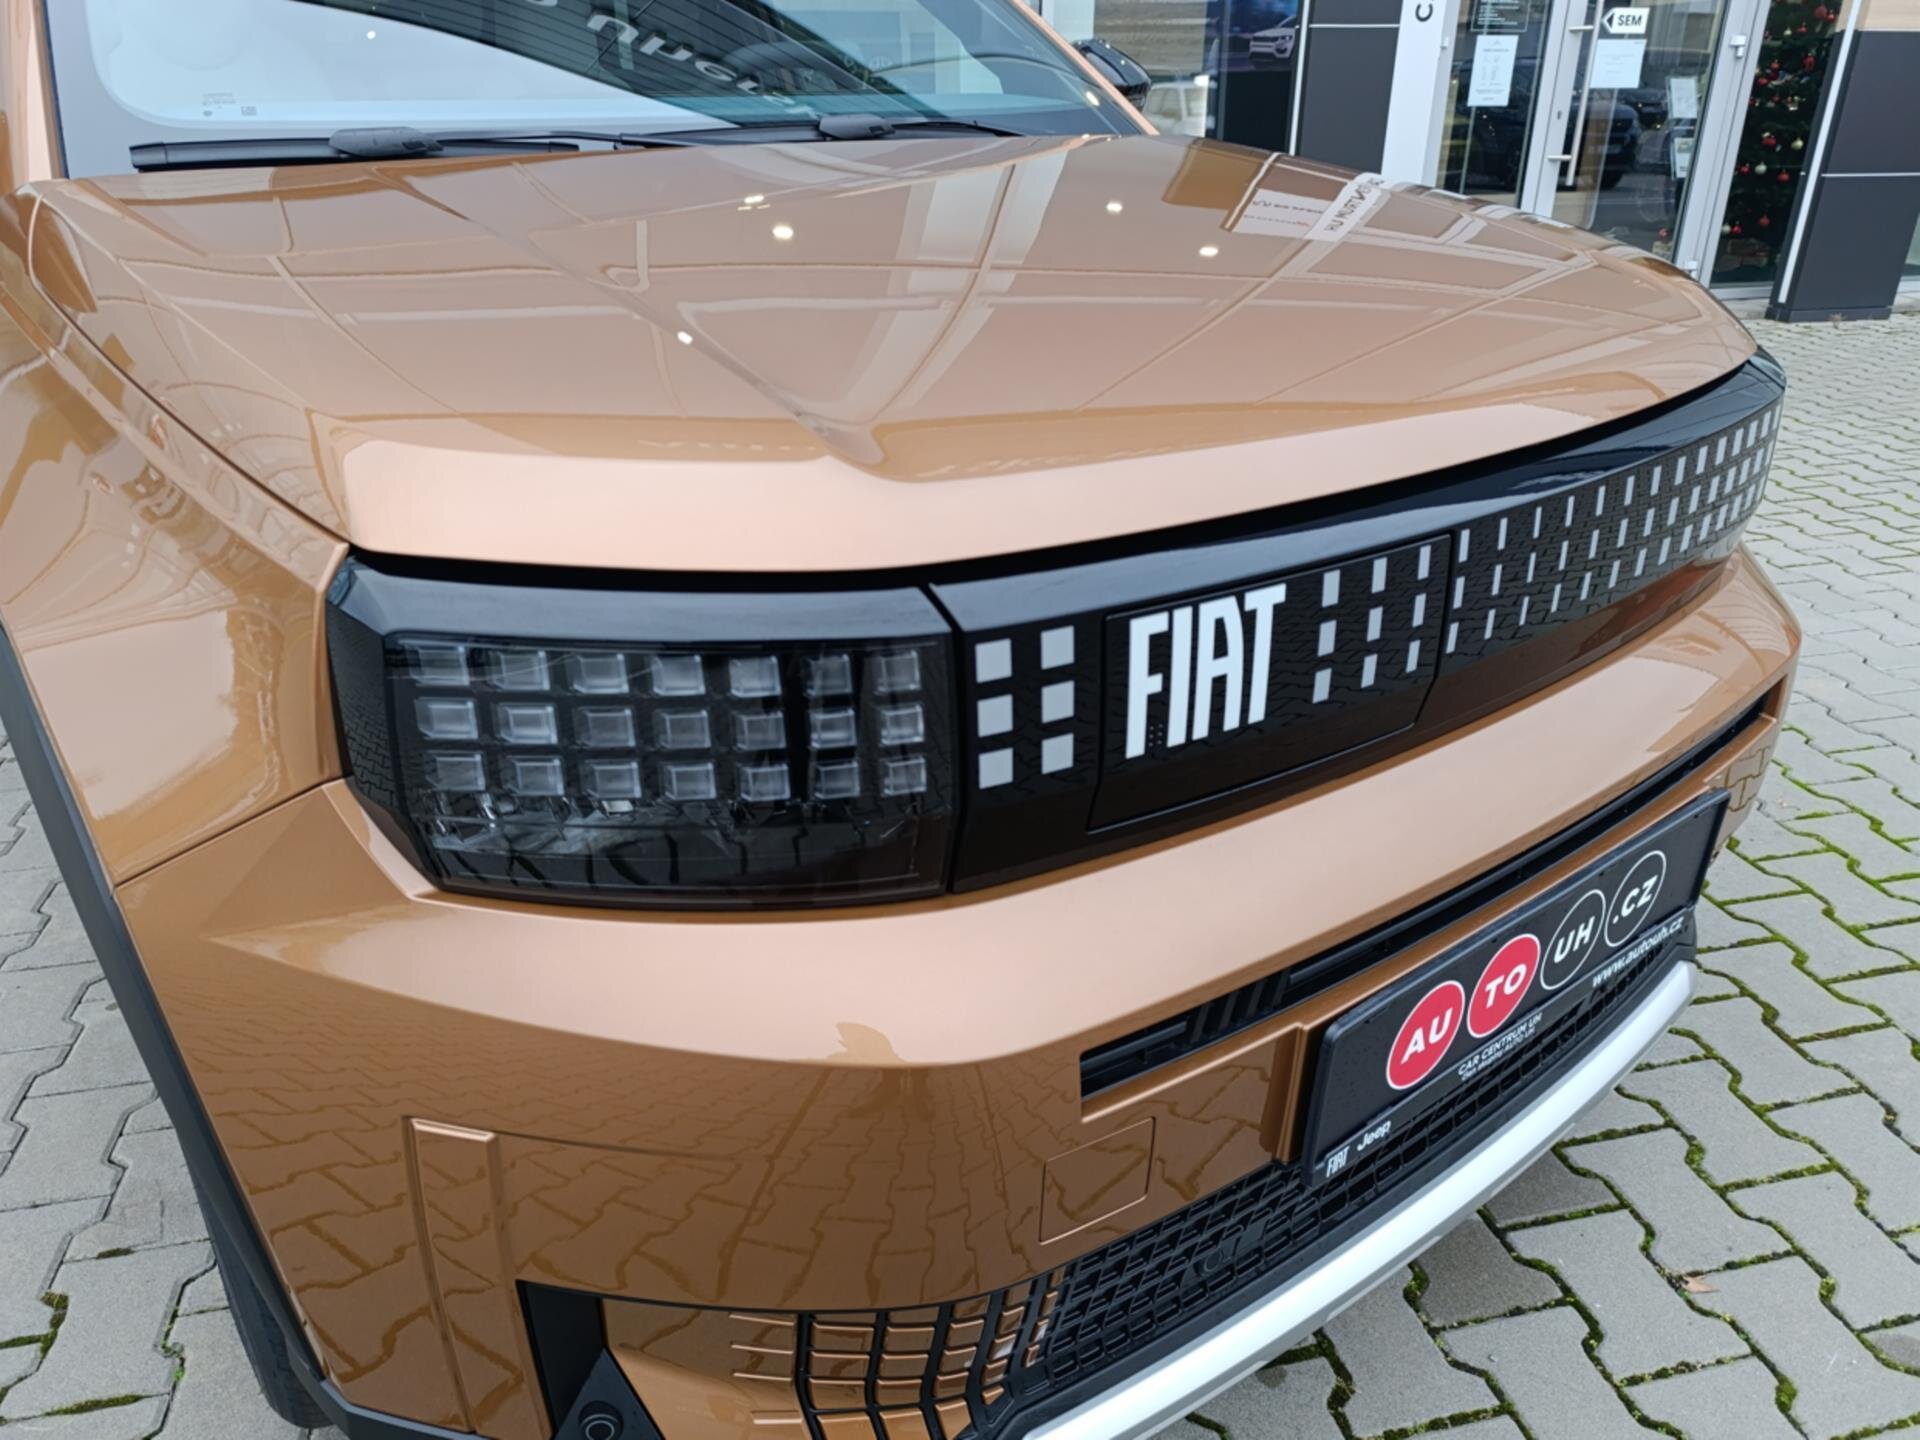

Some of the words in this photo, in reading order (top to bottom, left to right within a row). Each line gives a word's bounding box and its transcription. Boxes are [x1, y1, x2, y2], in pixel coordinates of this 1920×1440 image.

[1617, 14, 1643, 26] SEM
[1125, 582, 1287, 759] FIAT
[1458, 1055, 1480, 1075] CAR
[1481, 1022, 1528, 1060] CENTRUM
[1326, 1145, 1350, 1178] FIAT
[1356, 1120, 1392, 1151] Jeep
